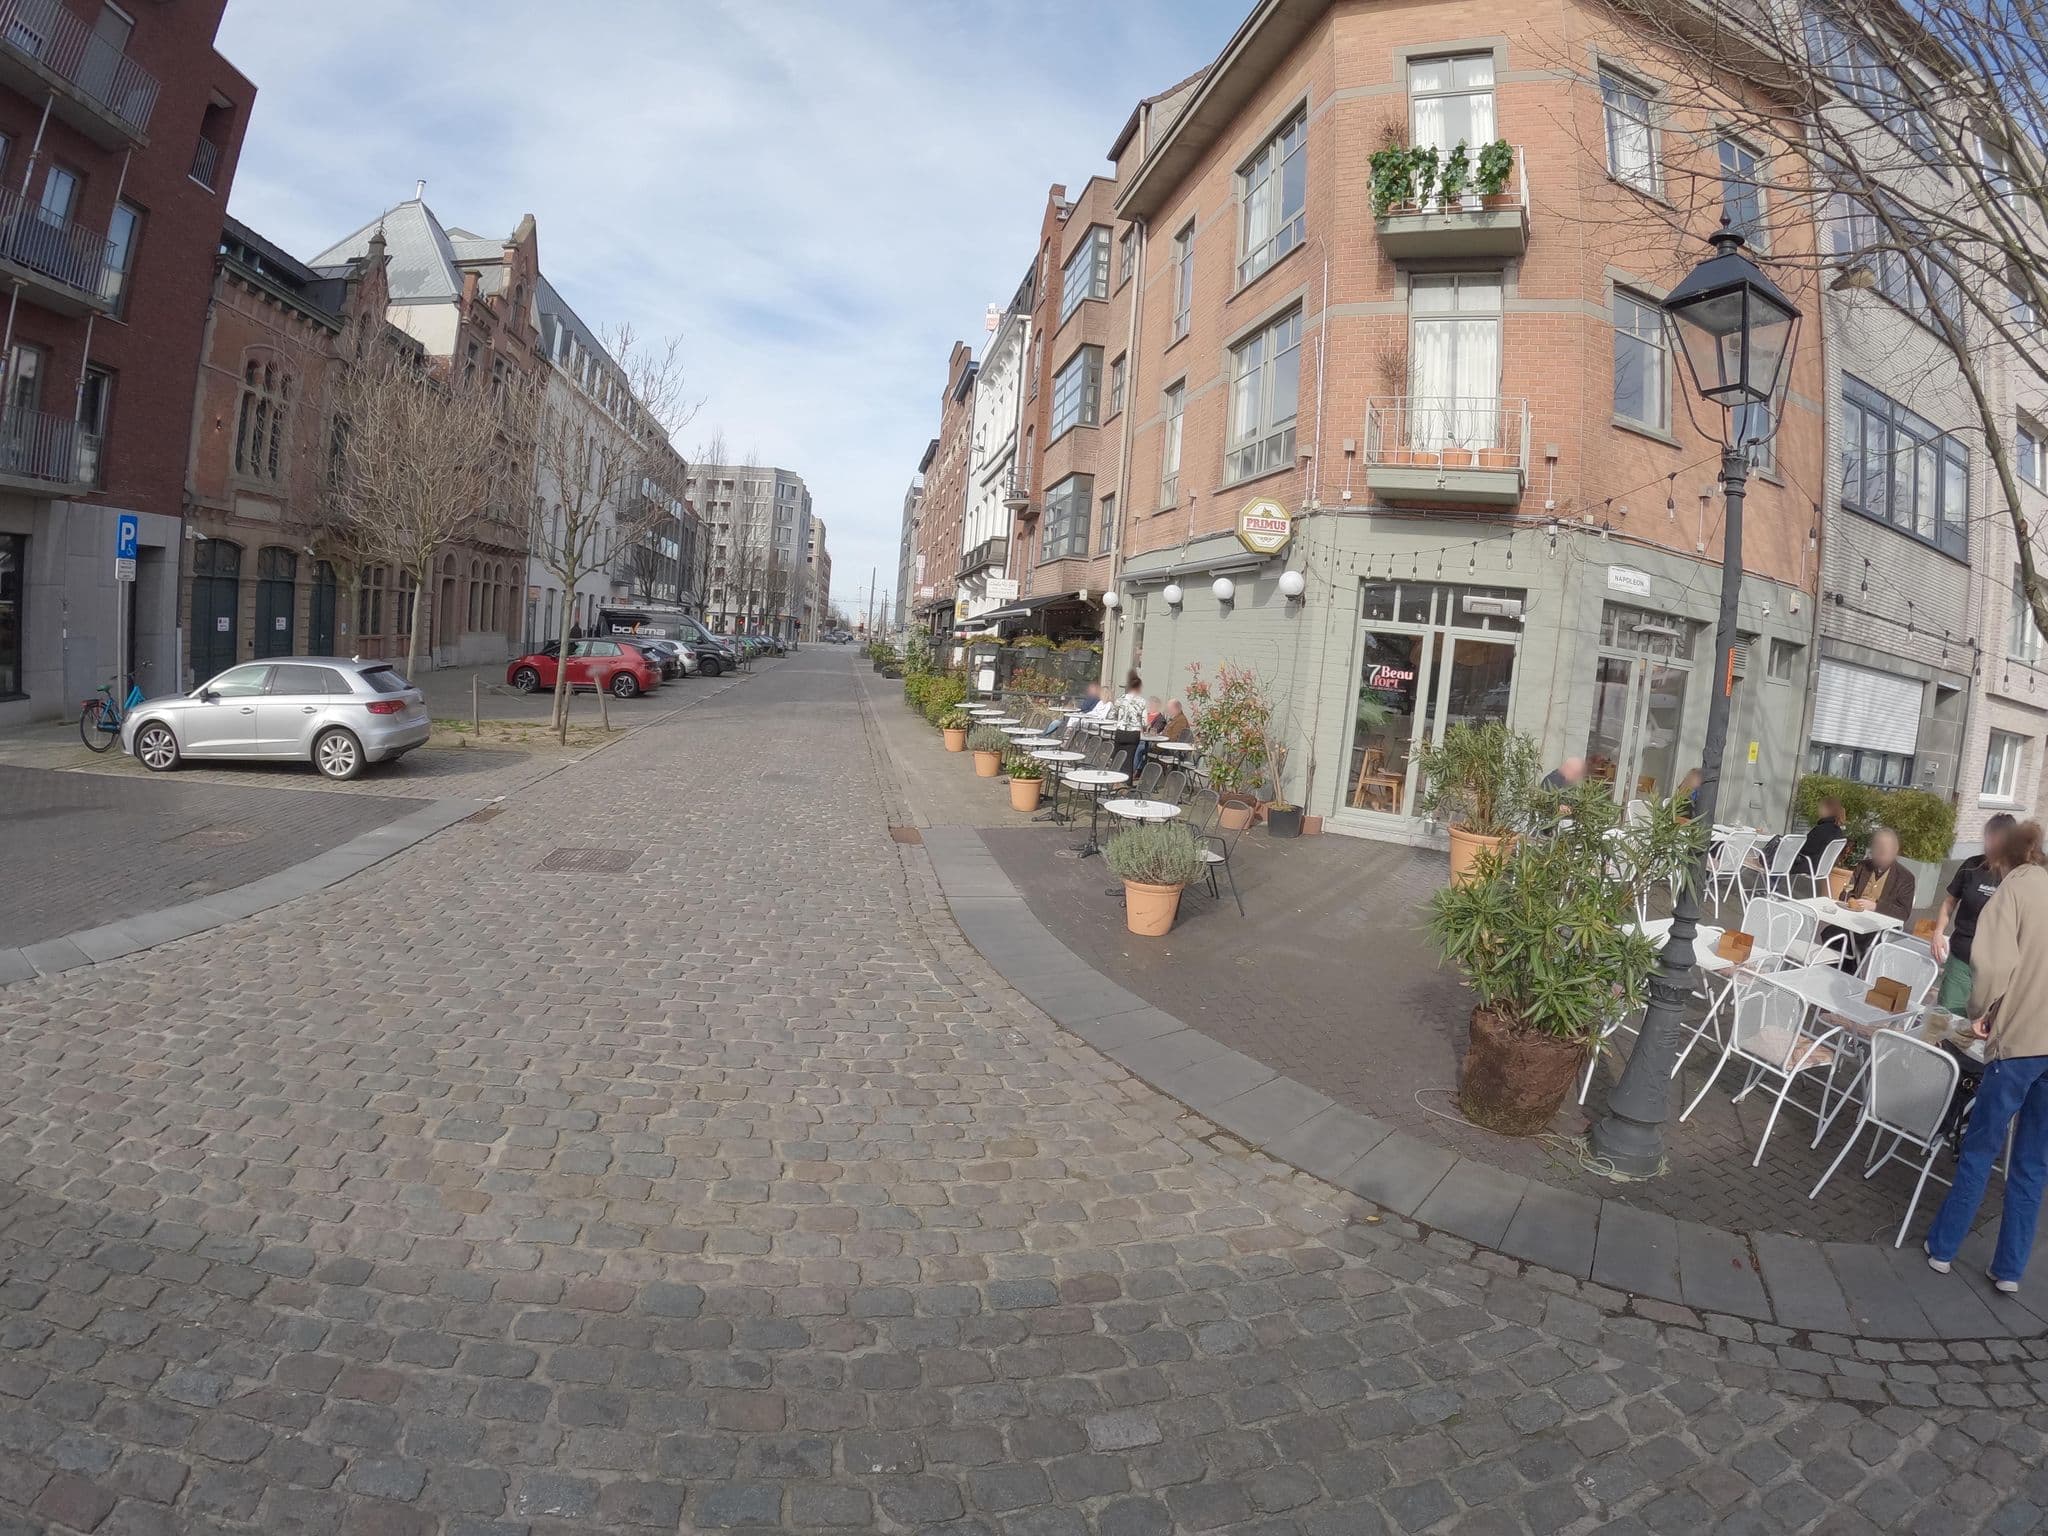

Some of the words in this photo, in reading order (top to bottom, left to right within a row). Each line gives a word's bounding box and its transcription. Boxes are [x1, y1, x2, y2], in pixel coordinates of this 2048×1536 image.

[1247, 518, 1286, 531] PRIMUS
[121, 522, 135, 551] P
[1614, 574, 1644, 587] NAPOLEON
[1381, 665, 1413, 680] Beau
[1374, 675, 1399, 688] fort
